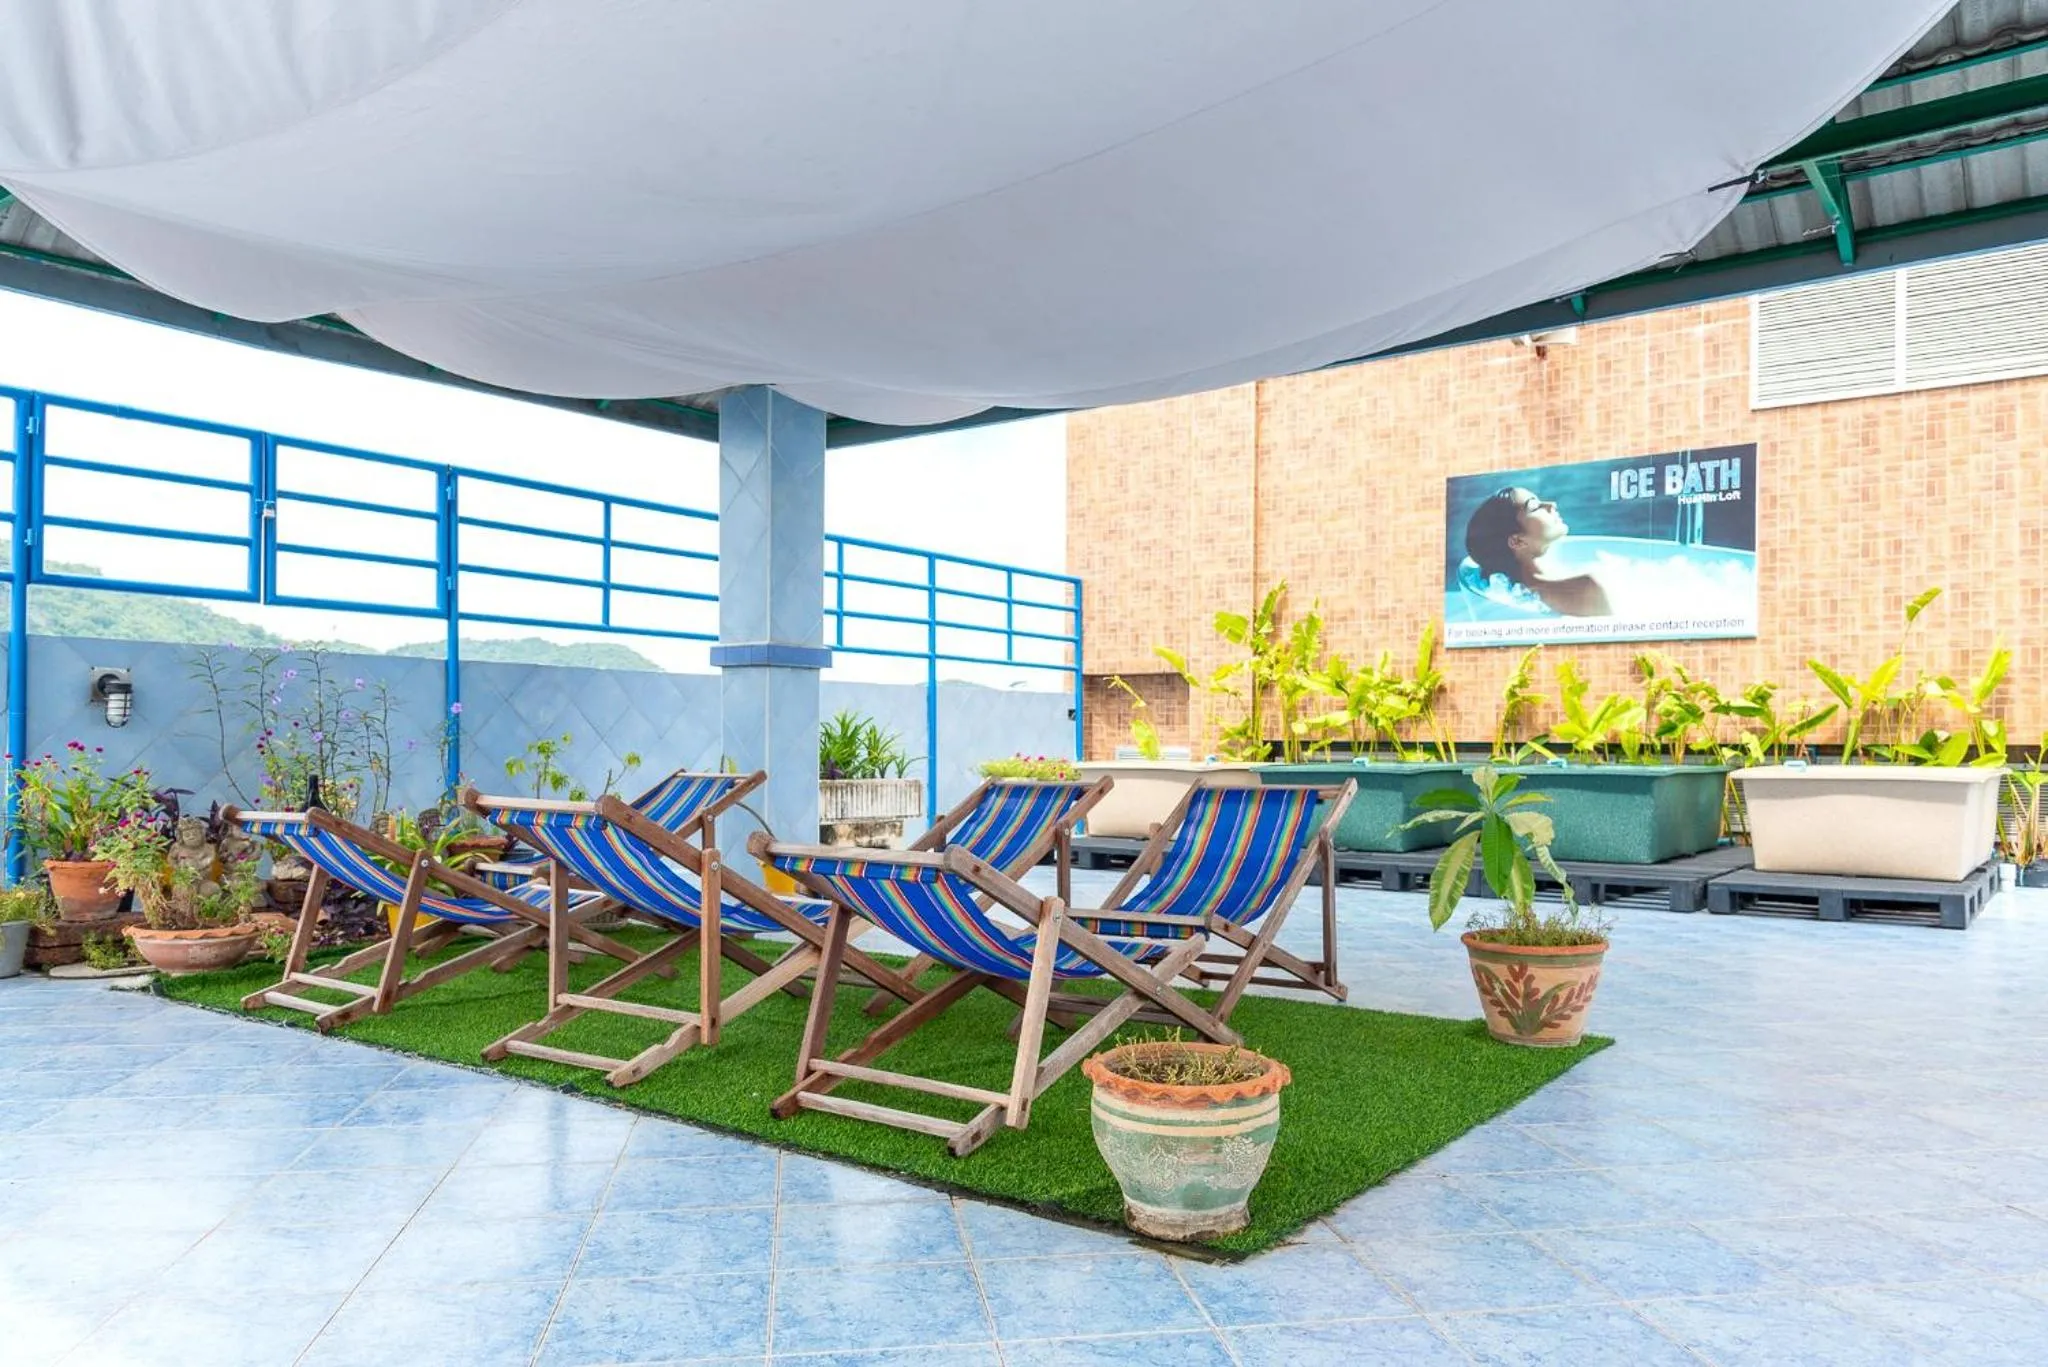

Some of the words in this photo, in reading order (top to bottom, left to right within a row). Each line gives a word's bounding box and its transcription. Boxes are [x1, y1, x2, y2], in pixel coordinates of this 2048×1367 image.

[1610, 467, 1656, 500] ICE
[1665, 458, 1741, 495] BATH
[1719, 490, 1741, 501] Loft
[1506, 626, 1523, 636] and
[1526, 626, 1550, 635] more
[1553, 623, 1609, 634] information
[1612, 621, 1646, 633] please
[1649, 619, 1689, 630] contact
[1692, 617, 1745, 630] reception
